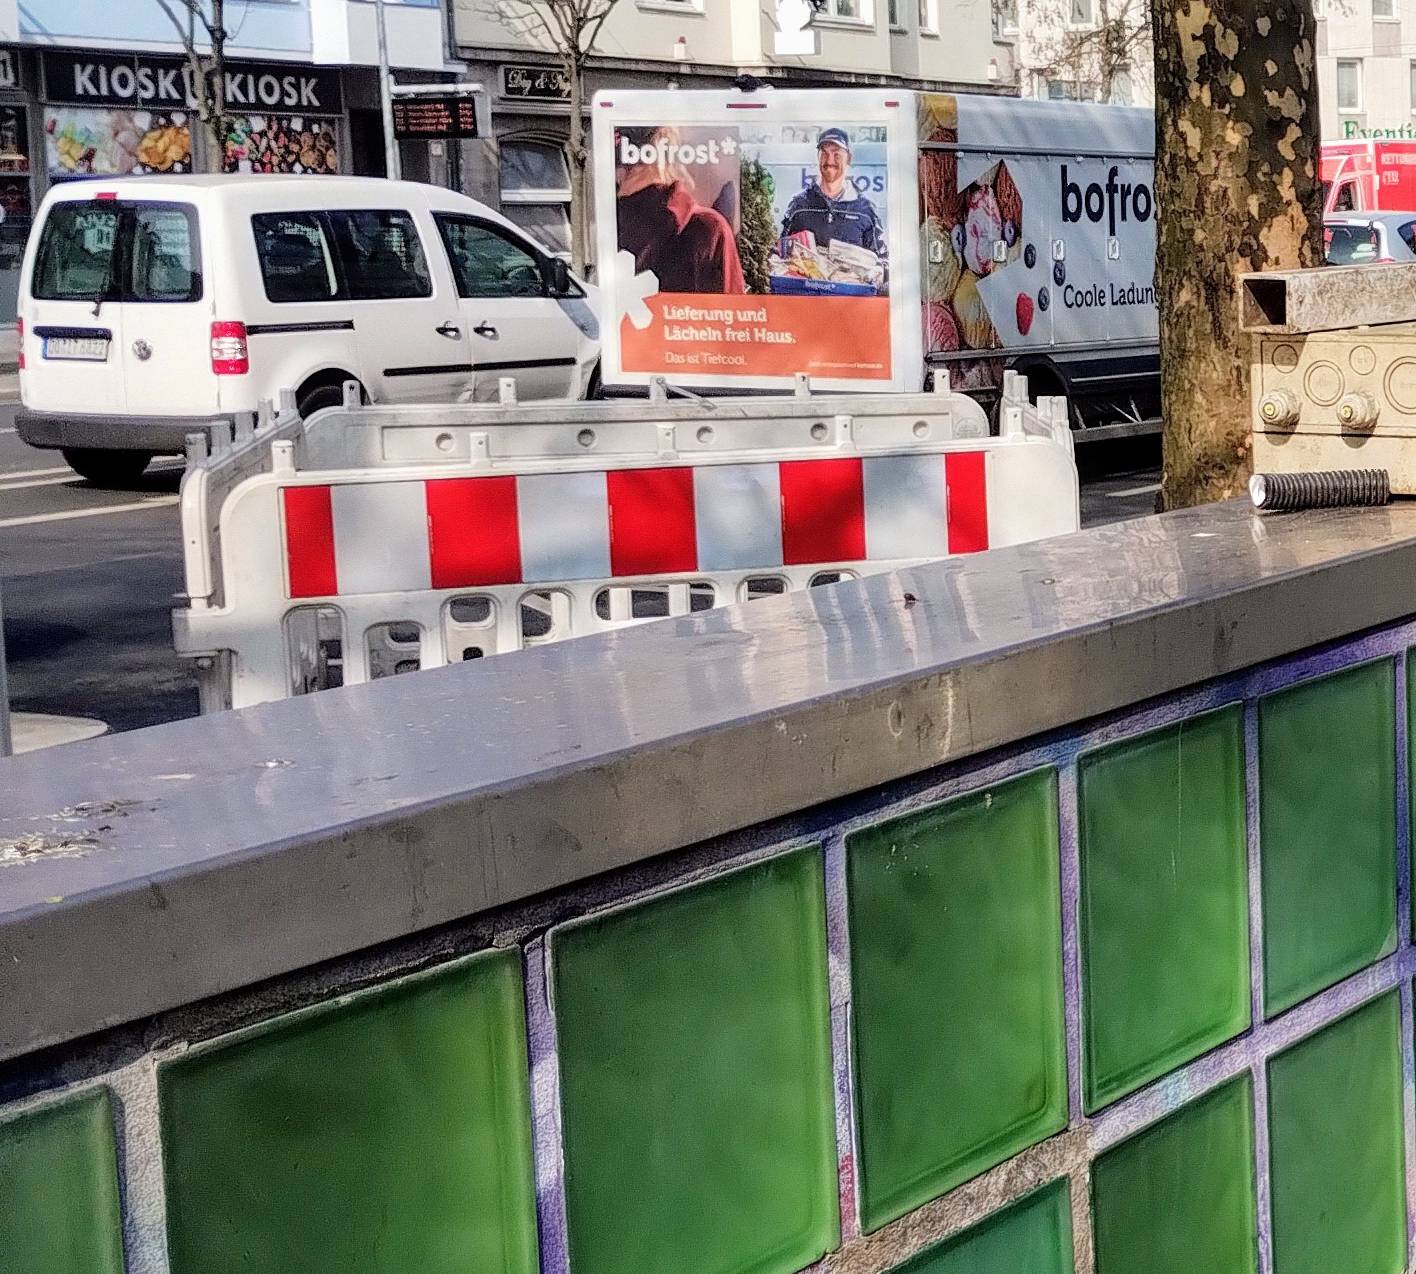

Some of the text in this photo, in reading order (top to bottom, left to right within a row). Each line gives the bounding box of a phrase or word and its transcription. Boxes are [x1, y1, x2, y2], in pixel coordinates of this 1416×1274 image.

[73, 63, 182, 99] KIOSK
[225, 71, 320, 107] KIOSK
[1061, 164, 1157, 236] bofro
[1064, 284, 1105, 308] Coole
[662, 305, 767, 325] Lieferung und
[664, 325, 797, 344] Lächeln frei Haus.
[664, 351, 685, 364] Das
[687, 352, 700, 364] ist
